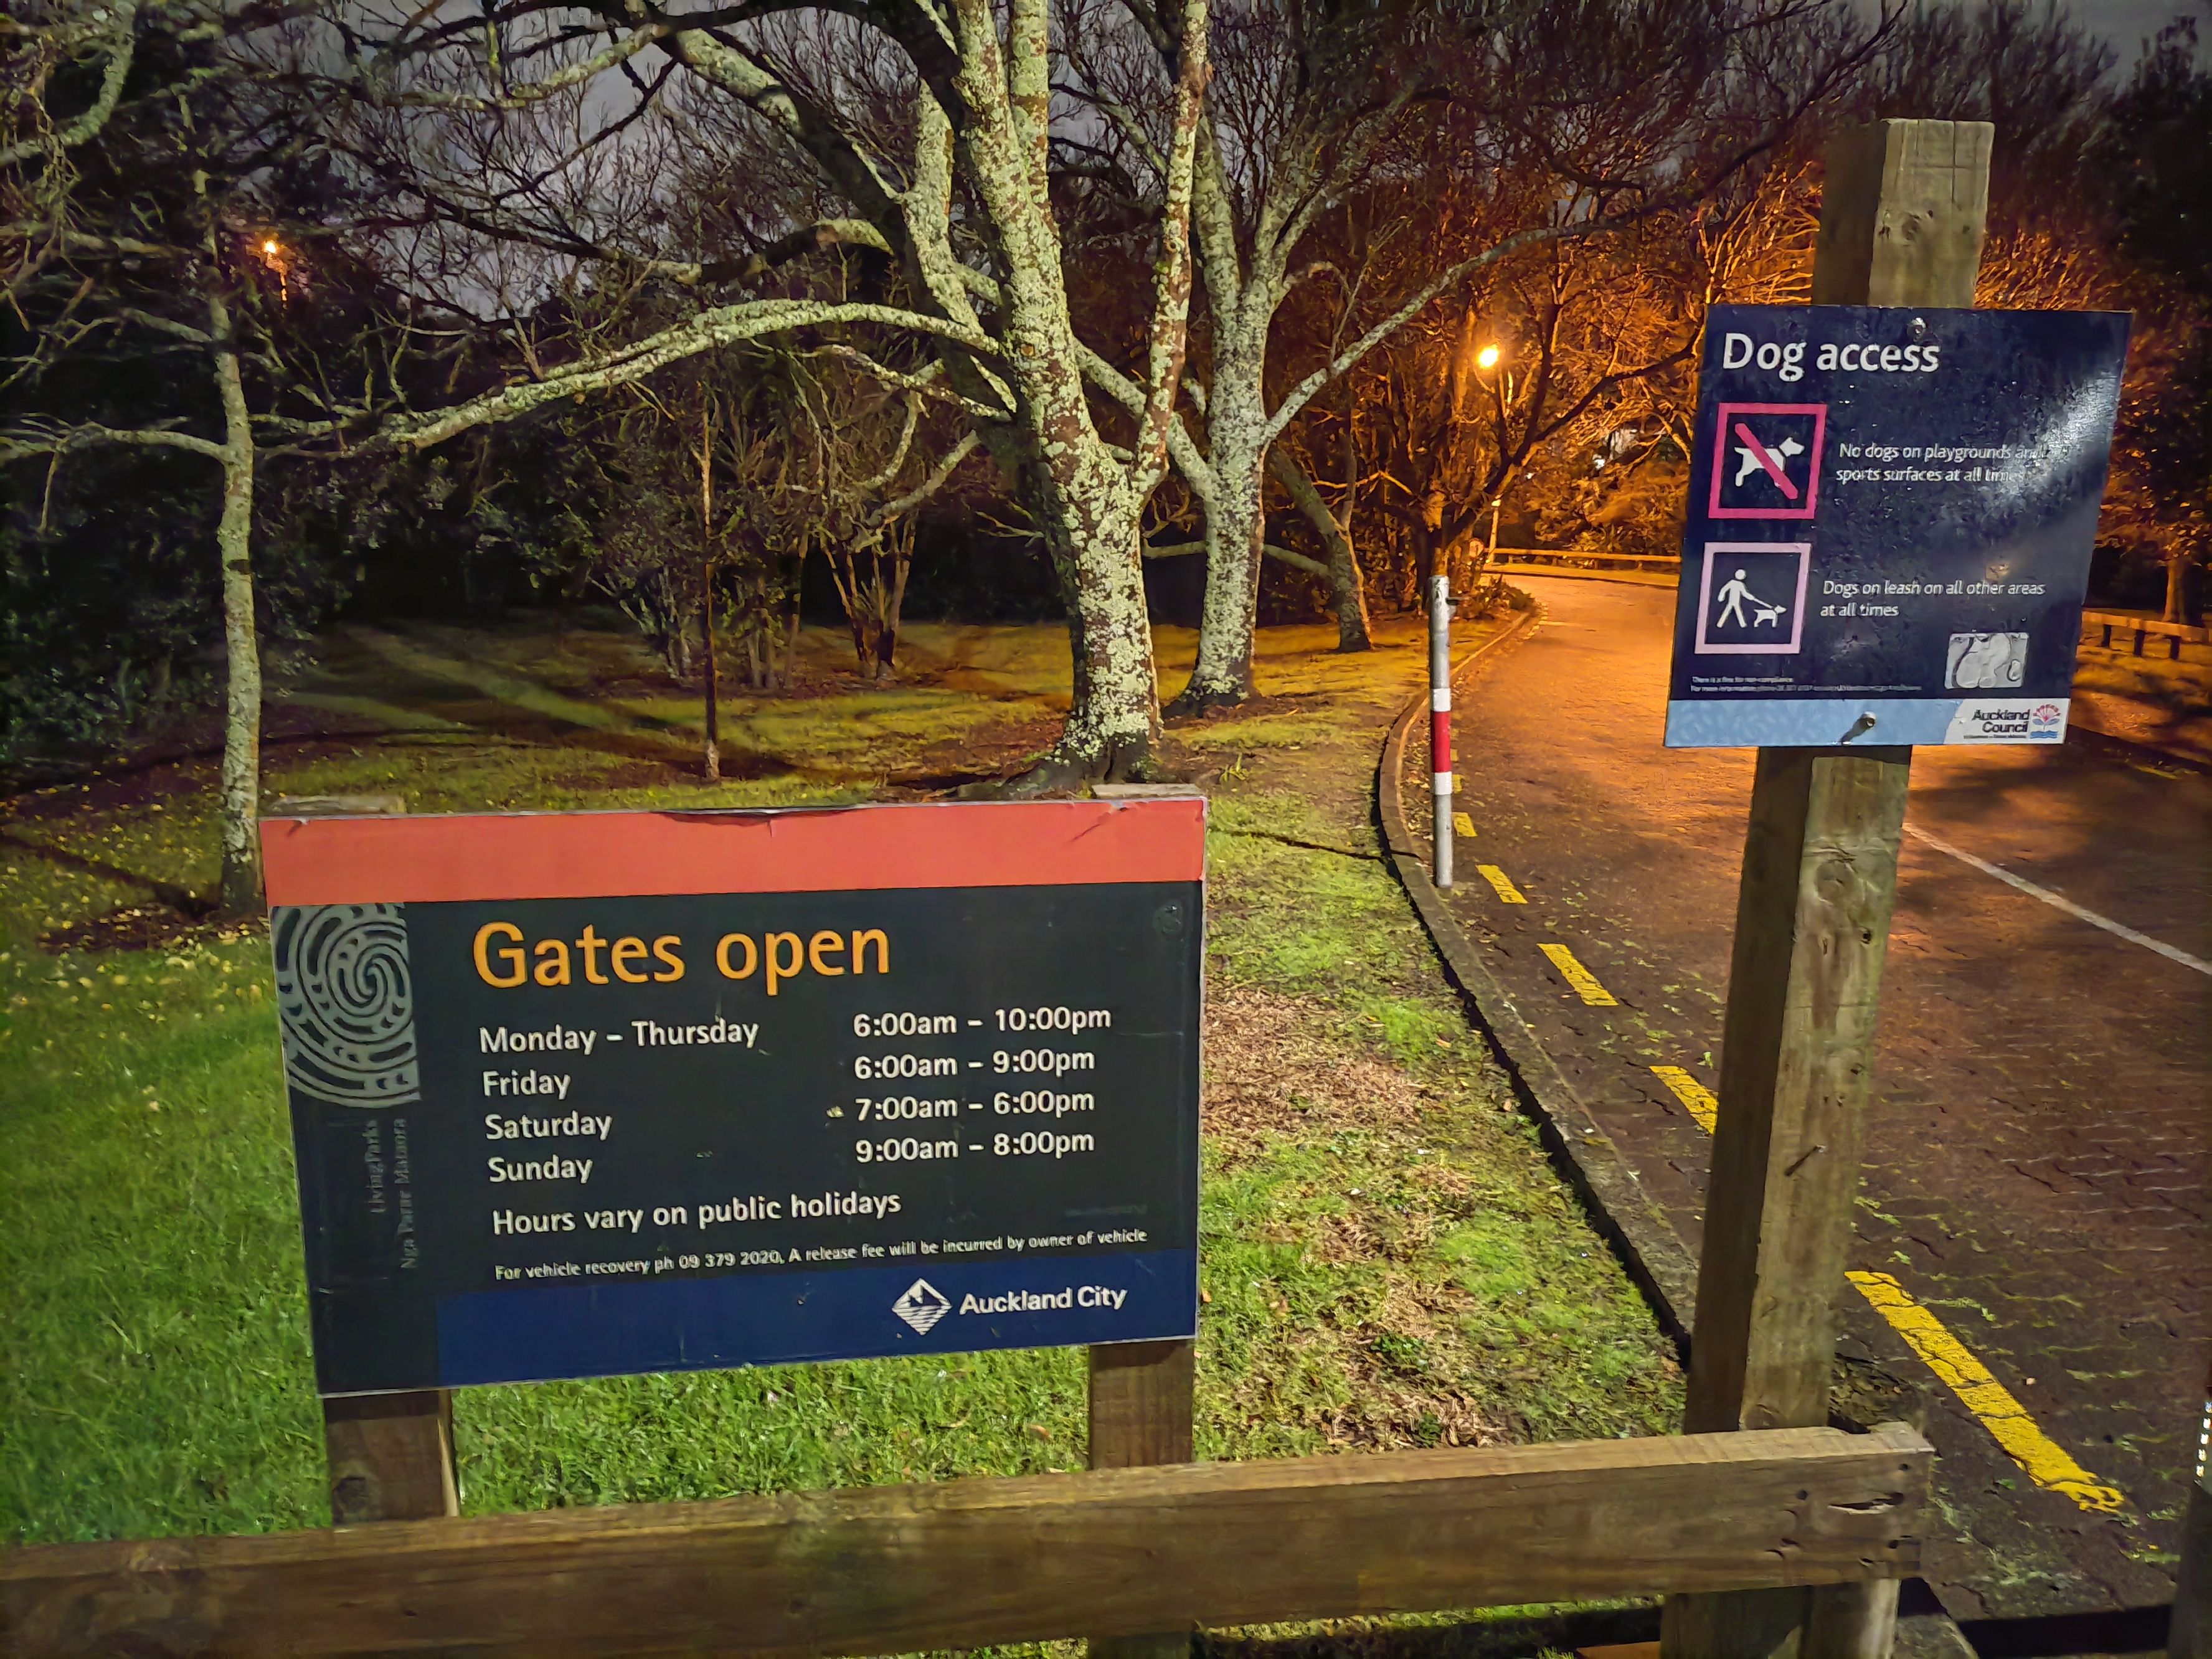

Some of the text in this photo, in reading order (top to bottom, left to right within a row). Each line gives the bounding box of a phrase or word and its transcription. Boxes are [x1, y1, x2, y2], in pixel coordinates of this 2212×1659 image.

[1723, 332, 1941, 382] Dog access
[1839, 443, 1861, 459] No
[1865, 442, 1899, 462] dogs
[1902, 445, 1921, 459] on
[1924, 443, 2011, 463] playgrounds
[1836, 468, 1880, 485] sports
[1883, 466, 1943, 482] surfaces
[1944, 468, 1961, 482] at
[1963, 466, 1982, 482] all
[1823, 580, 2046, 598] Dogs on leash on all other areas
[1820, 602, 1899, 617] at all times
[1972, 709, 2031, 721] Auckland
[1982, 721, 2028, 733] Council
[473, 921, 890, 996] Gates open
[479, 1024, 597, 1055] Monday
[631, 1018, 759, 1049] Thursday
[853, 1013, 957, 1037] 6:00am
[995, 1006, 1112, 1034] 10:00pm
[854, 1054, 958, 1079] 6:00am
[993, 1049, 1095, 1077] 9:00pm
[483, 1069, 571, 1100] Friday
[854, 1096, 958, 1122] 7:00am
[993, 1090, 1095, 1118] 6:00pm
[485, 1110, 613, 1141] Saturday
[856, 1137, 959, 1163] 9:00am
[993, 1131, 1095, 1159] 8:00pm
[487, 1155, 593, 1184] Sunday
[493, 1190, 902, 1235] Hours vary on public holidays
[494, 1265, 522, 1280] For
[525, 1261, 581, 1278] vehicle
[585, 1258, 651, 1276] recovery
[655, 1255, 674, 1274] ph
[679, 1254, 701, 1269] 09
[704, 1252, 735, 1268] 379
[788, 1247, 802, 1262] A
[806, 1245, 858, 1261] release
[862, 1243, 886, 1258] fee
[889, 1241, 917, 1256] will
[920, 1240, 939, 1255] be
[943, 1236, 1004, 1254] incurred
[1007, 1235, 1026, 1252] by
[1029, 1236, 1074, 1248] owner
[1077, 1231, 1095, 1246] of
[1097, 1228, 1149, 1244] vehicle
[959, 1285, 1128, 1315] Auckland City
